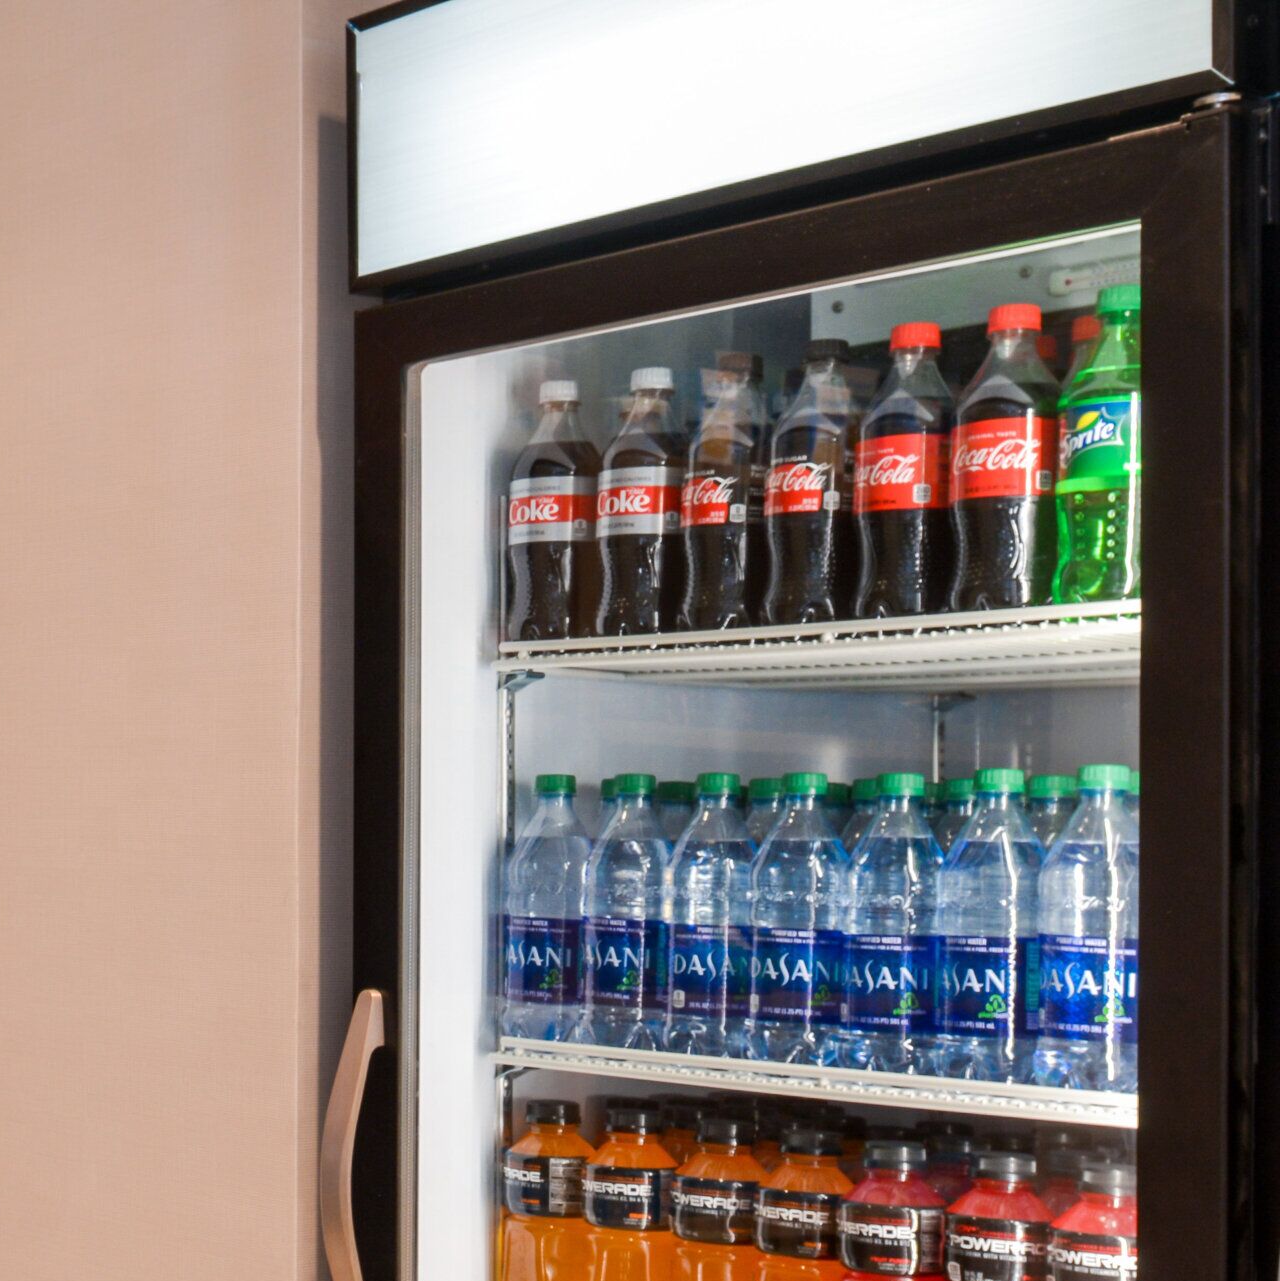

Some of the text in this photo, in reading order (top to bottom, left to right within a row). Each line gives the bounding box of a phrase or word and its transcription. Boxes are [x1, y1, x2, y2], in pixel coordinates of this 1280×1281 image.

[1064, 421, 1116, 456] Sprite
[508, 500, 559, 526] Coke
[597, 490, 651, 516] Coke
